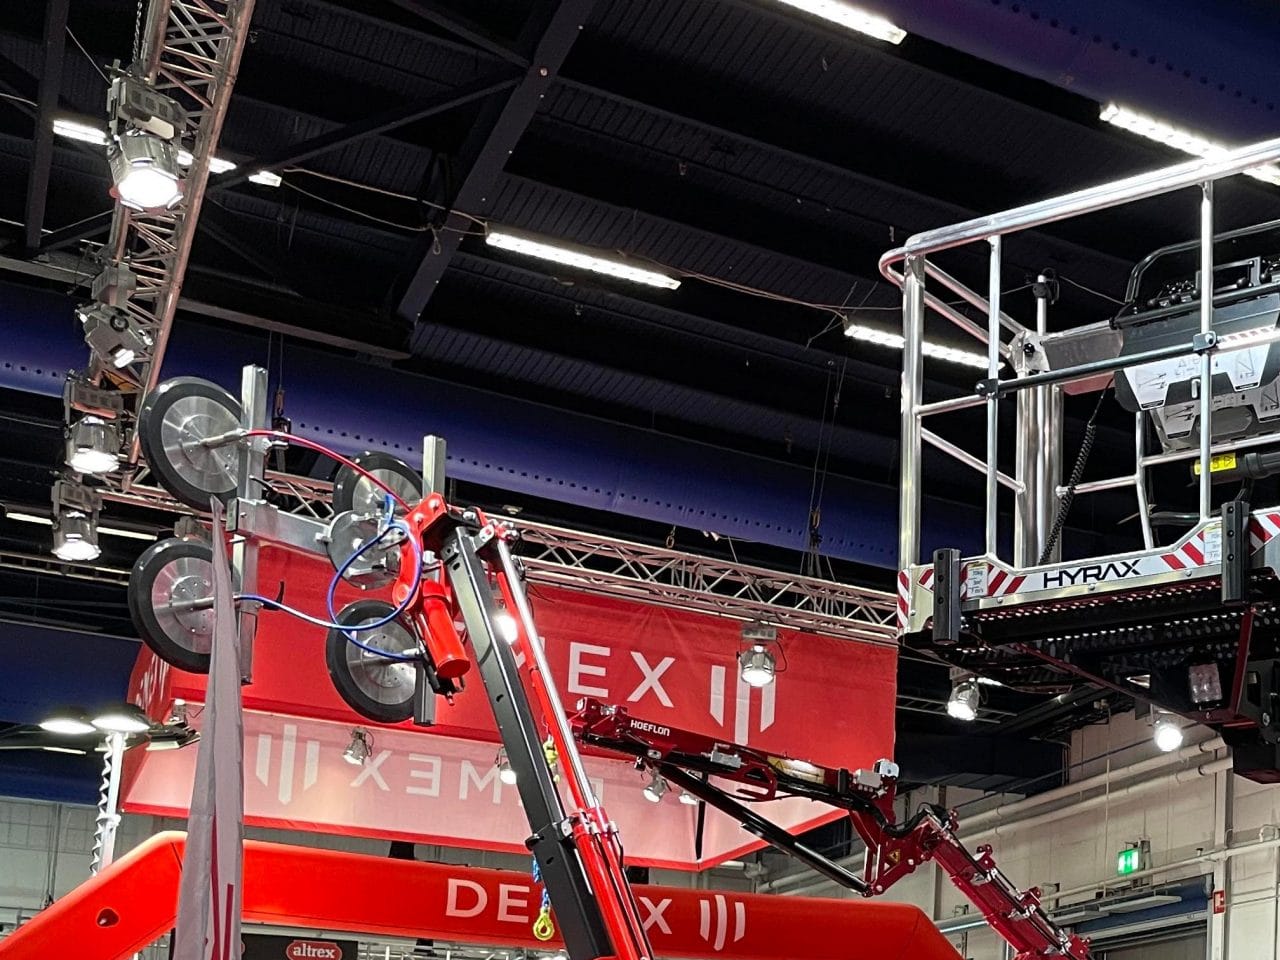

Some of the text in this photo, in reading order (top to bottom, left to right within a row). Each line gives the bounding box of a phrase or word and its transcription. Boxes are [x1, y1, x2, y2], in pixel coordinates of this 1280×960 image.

[1043, 559, 1141, 589] HYRAX
[630, 719, 671, 737] HOEFLON
[445, 878, 672, 935] DEX
[292, 943, 335, 959] altrex
